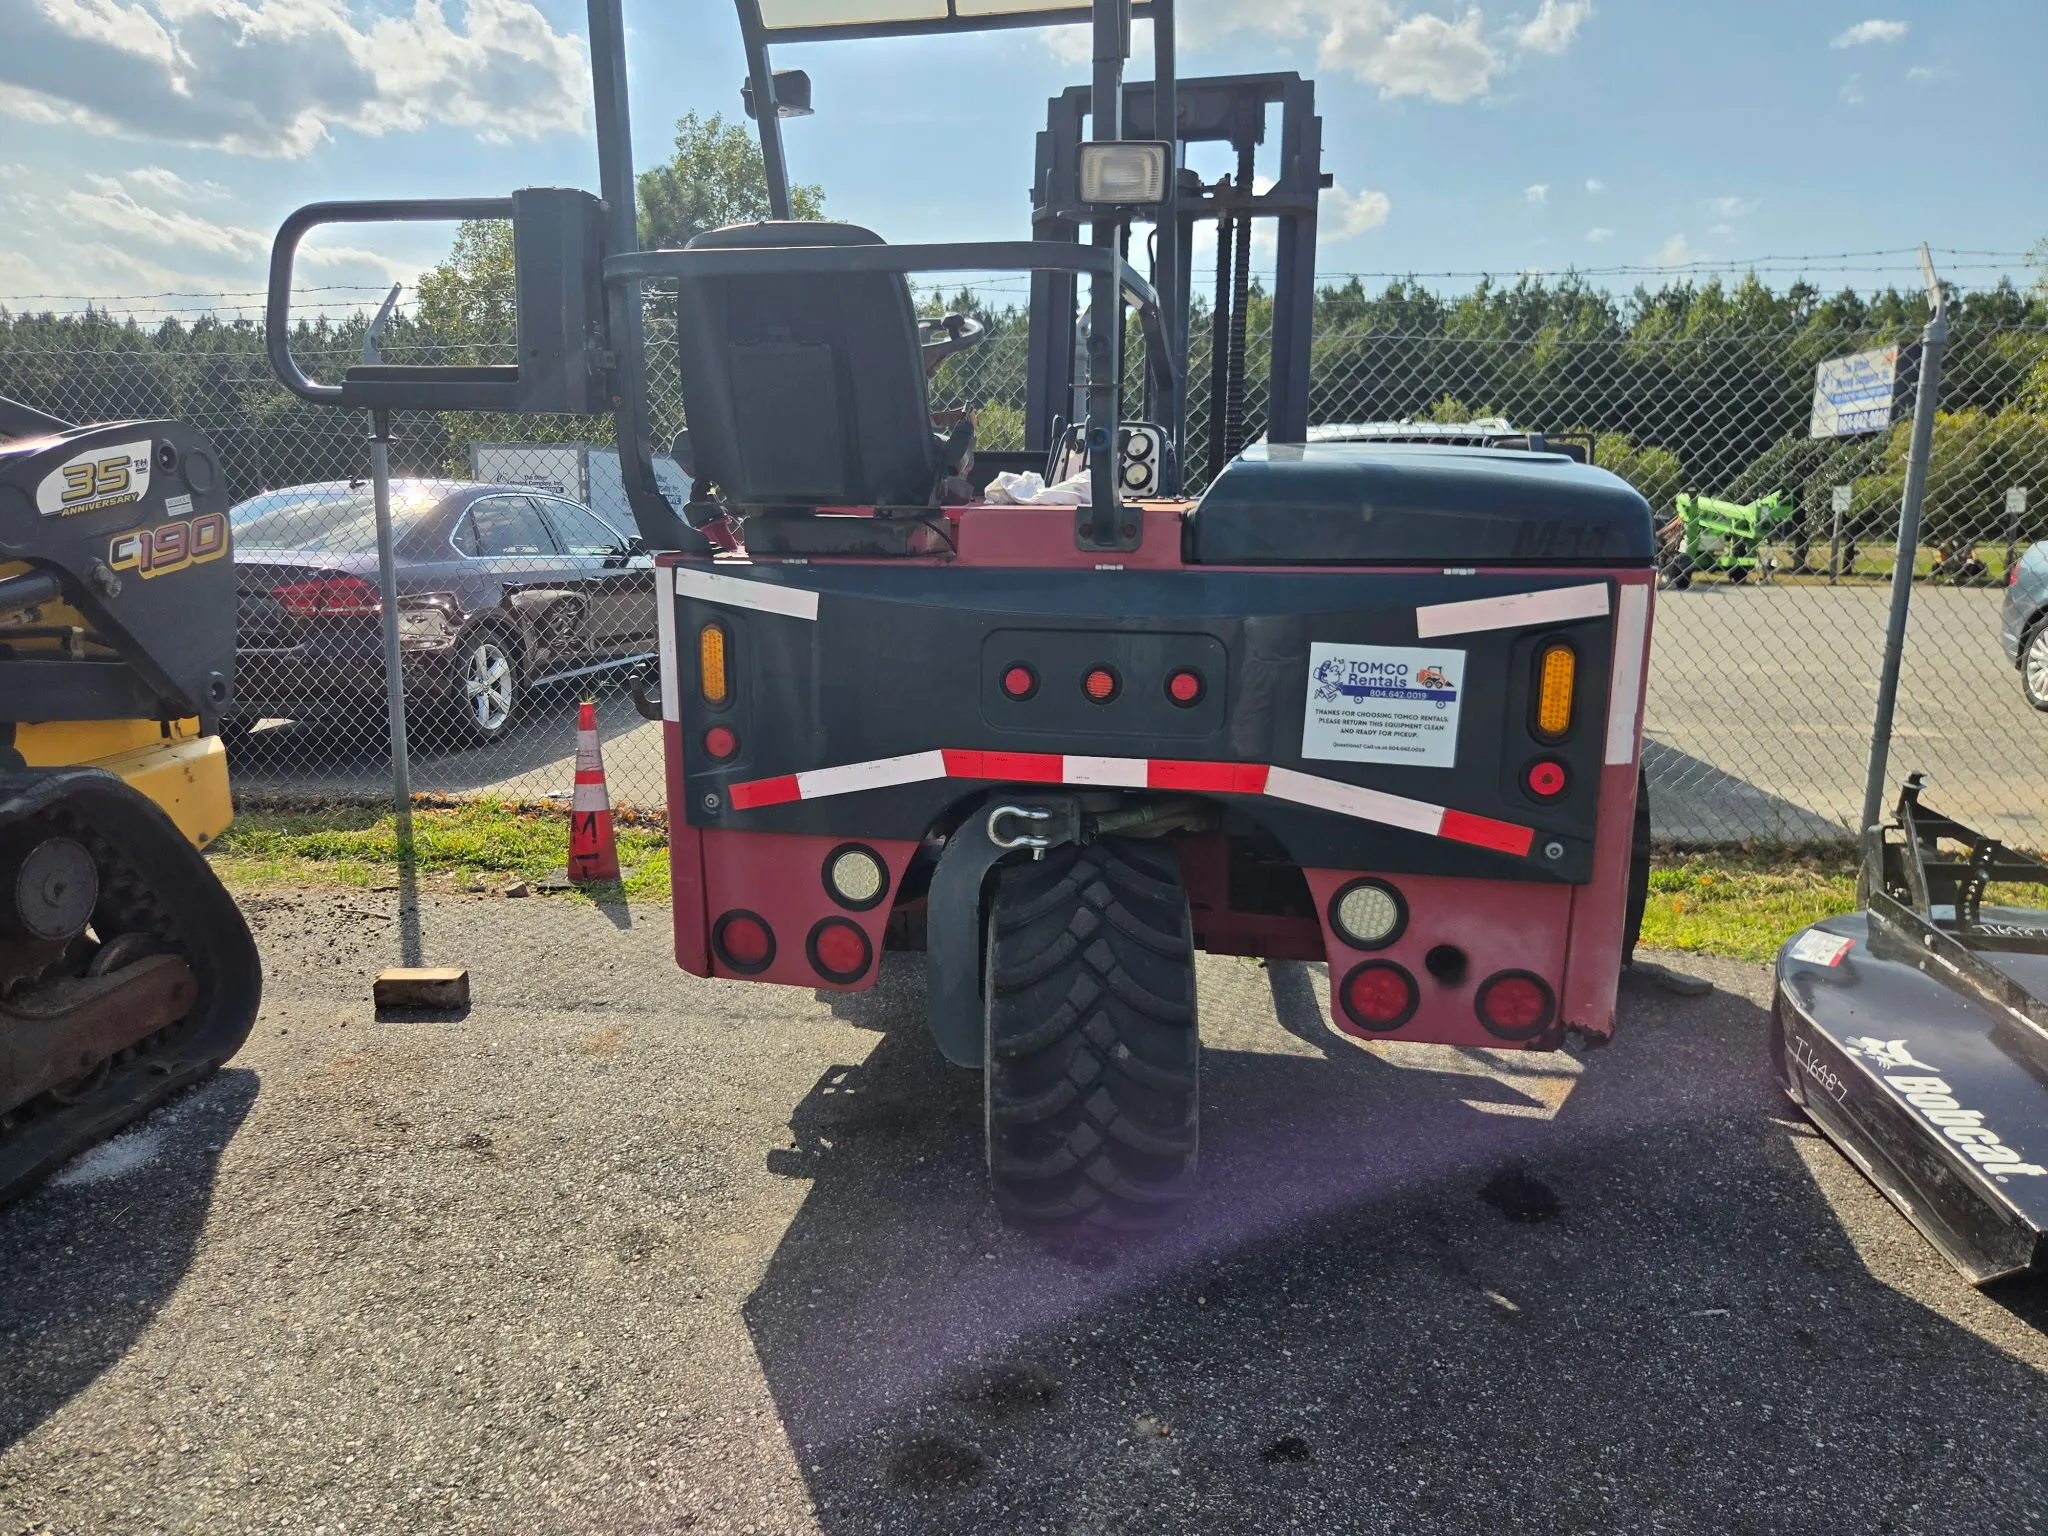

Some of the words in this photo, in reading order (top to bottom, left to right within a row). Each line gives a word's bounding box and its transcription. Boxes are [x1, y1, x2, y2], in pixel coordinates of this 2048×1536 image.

[61, 456, 131, 504] 35
[133, 459, 148, 467] TH
[61, 492, 139, 516] ANNIVERSARY
[109, 513, 228, 579] C190
[1348, 661, 1409, 676] TOMCO
[1348, 673, 1407, 688] Rentals
[1369, 689, 1427, 700] 804.642.0019
[1315, 708, 1340, 716] THANKS
[1357, 711, 1392, 719] CHOOSING
[1384, 721, 1422, 729] EQUIPMENT
[1424, 723, 1444, 731] CLEAN
[572, 810, 597, 845] M
[1884, 1076, 2047, 1176] Bobcat
